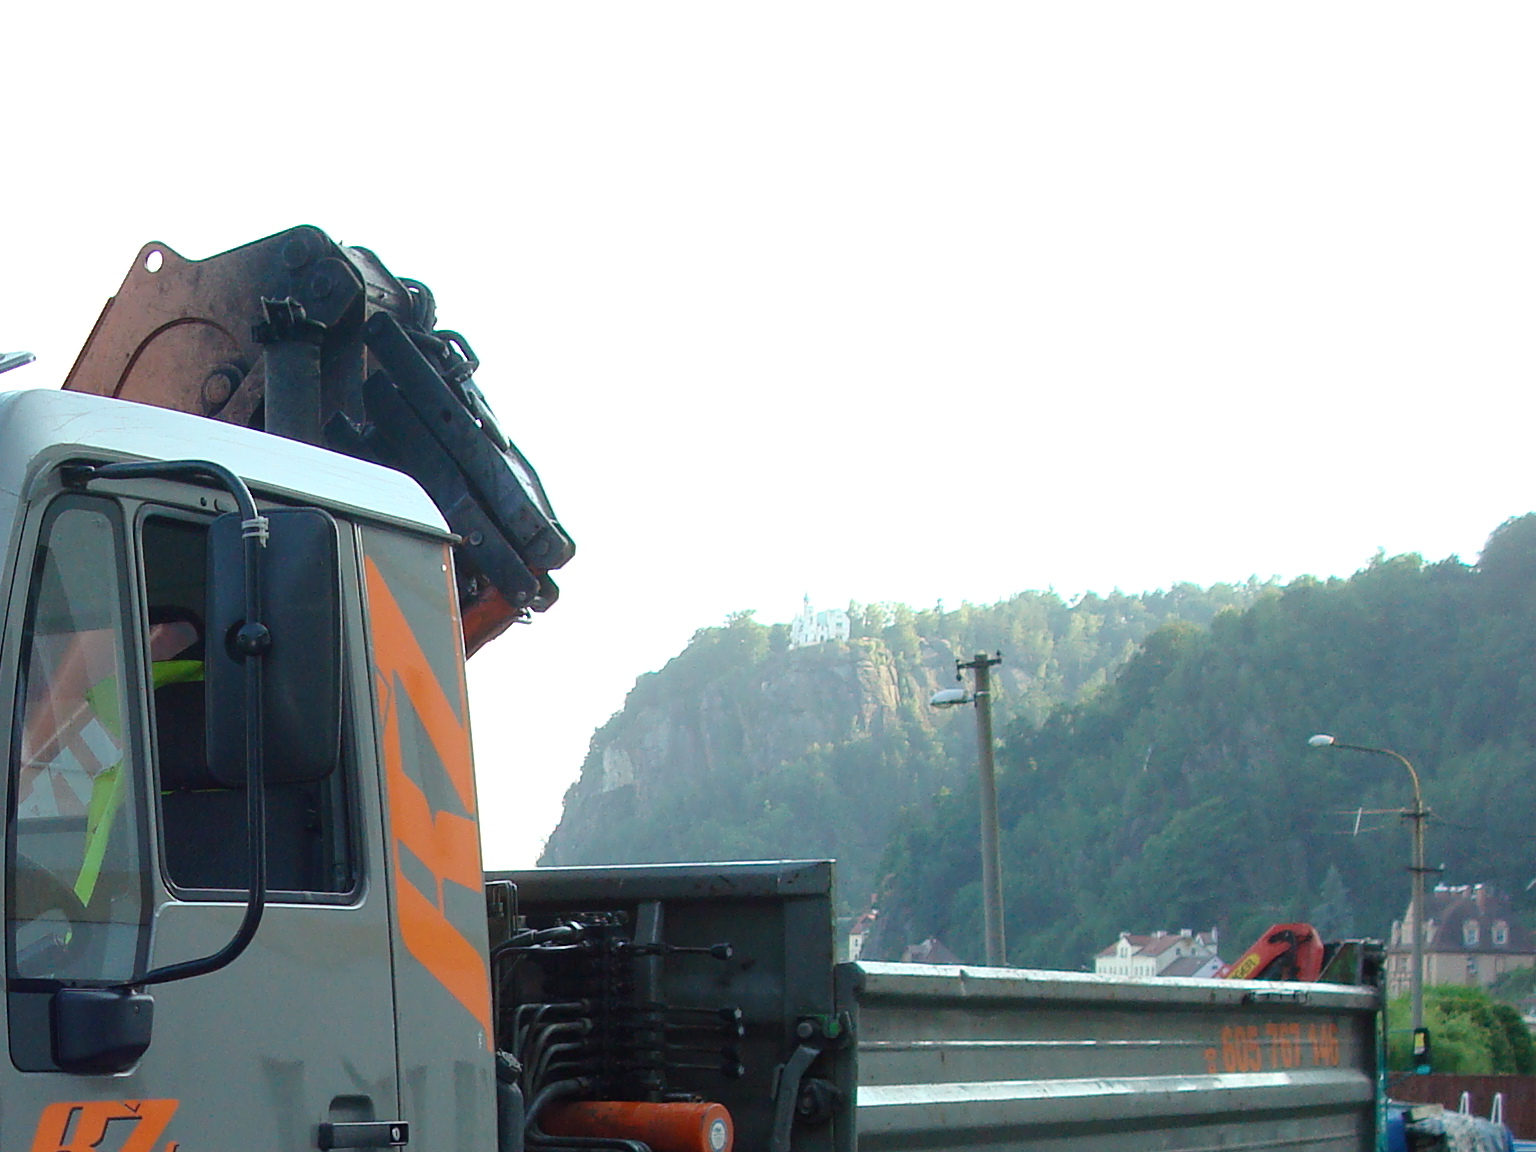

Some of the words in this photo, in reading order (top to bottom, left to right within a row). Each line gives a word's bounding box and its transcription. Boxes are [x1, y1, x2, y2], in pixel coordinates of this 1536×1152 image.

[1221, 1025, 1262, 1072] 605
[1265, 1022, 1301, 1068] 767
[1308, 1022, 1340, 1067] 146
